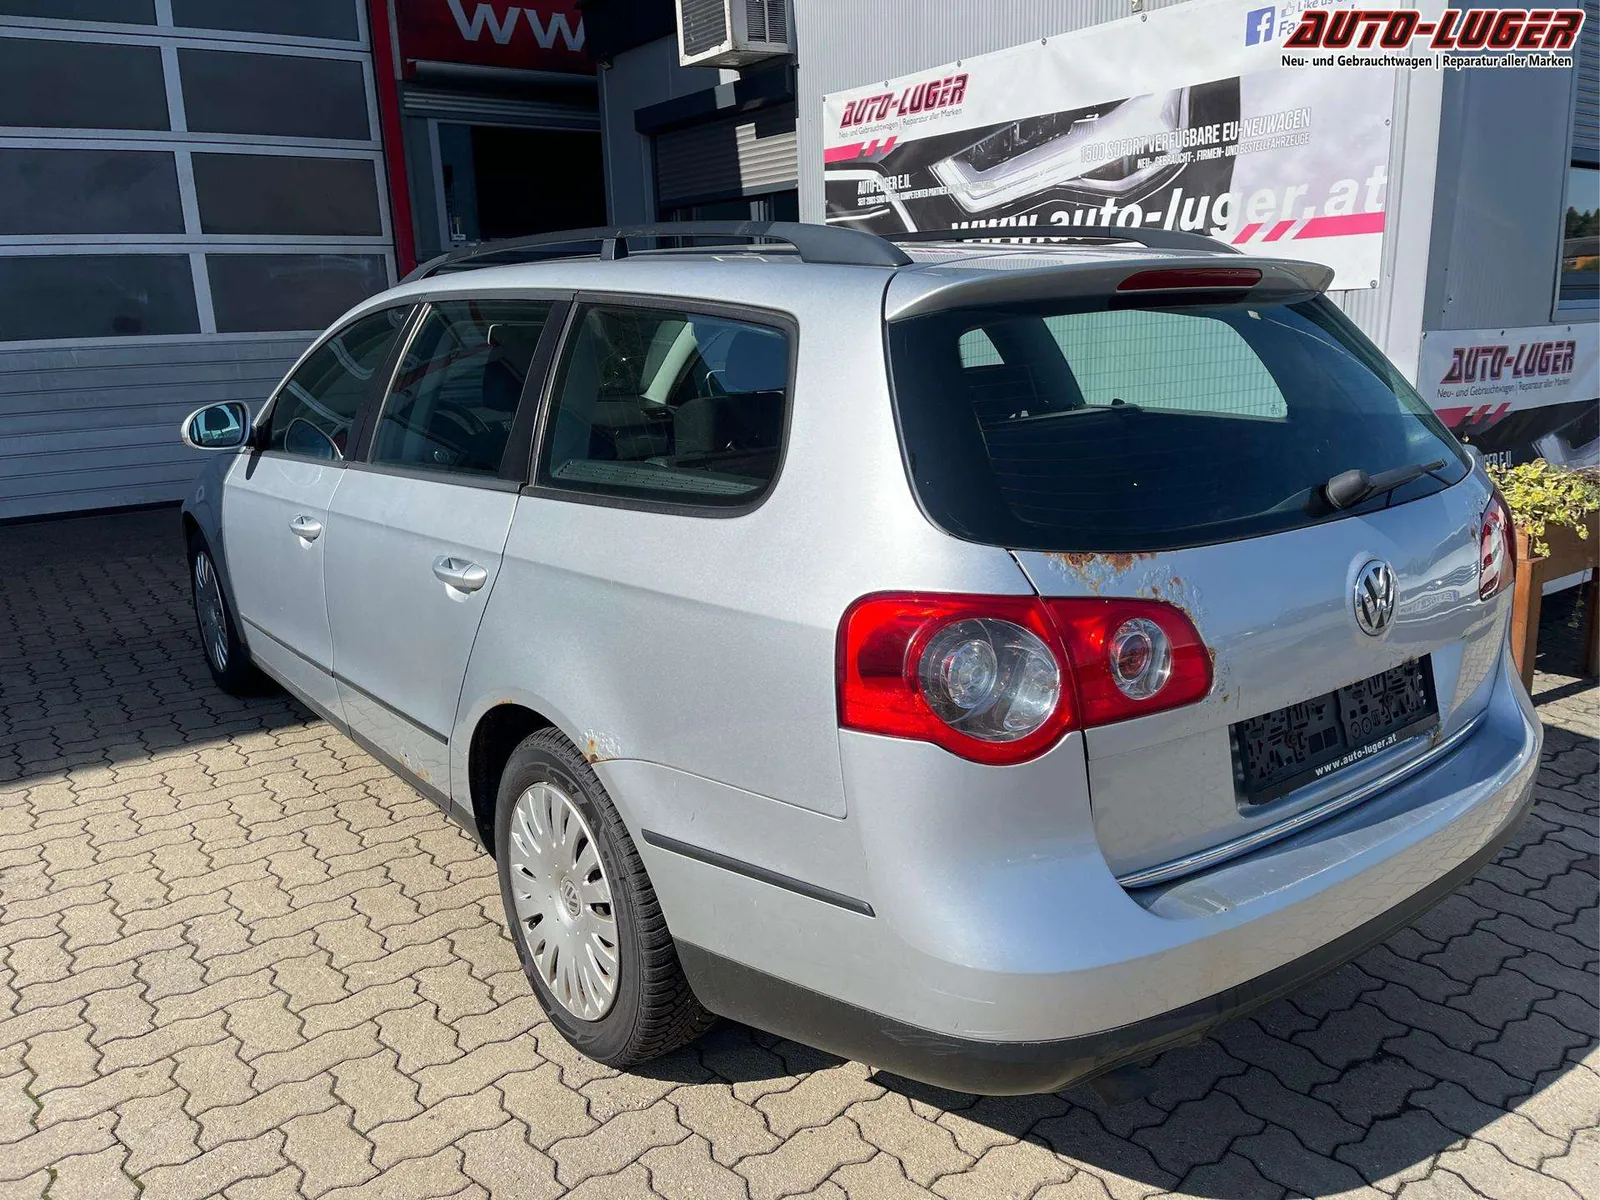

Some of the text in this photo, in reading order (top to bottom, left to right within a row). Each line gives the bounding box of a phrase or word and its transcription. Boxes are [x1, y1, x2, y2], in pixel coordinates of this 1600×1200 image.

[840, 73, 968, 129] AUTO-LUGER
[1107, 136, 1147, 159] SOFORT
[1147, 123, 1221, 153] VERFÜGBARE
[1222, 107, 1312, 141] EU-NEUWAGEN
[1440, 340, 1577, 385] AUTO-LUGER
[1455, 388, 1469, 398] und
[1315, 733, 1398, 777] www.auto-luger.at
